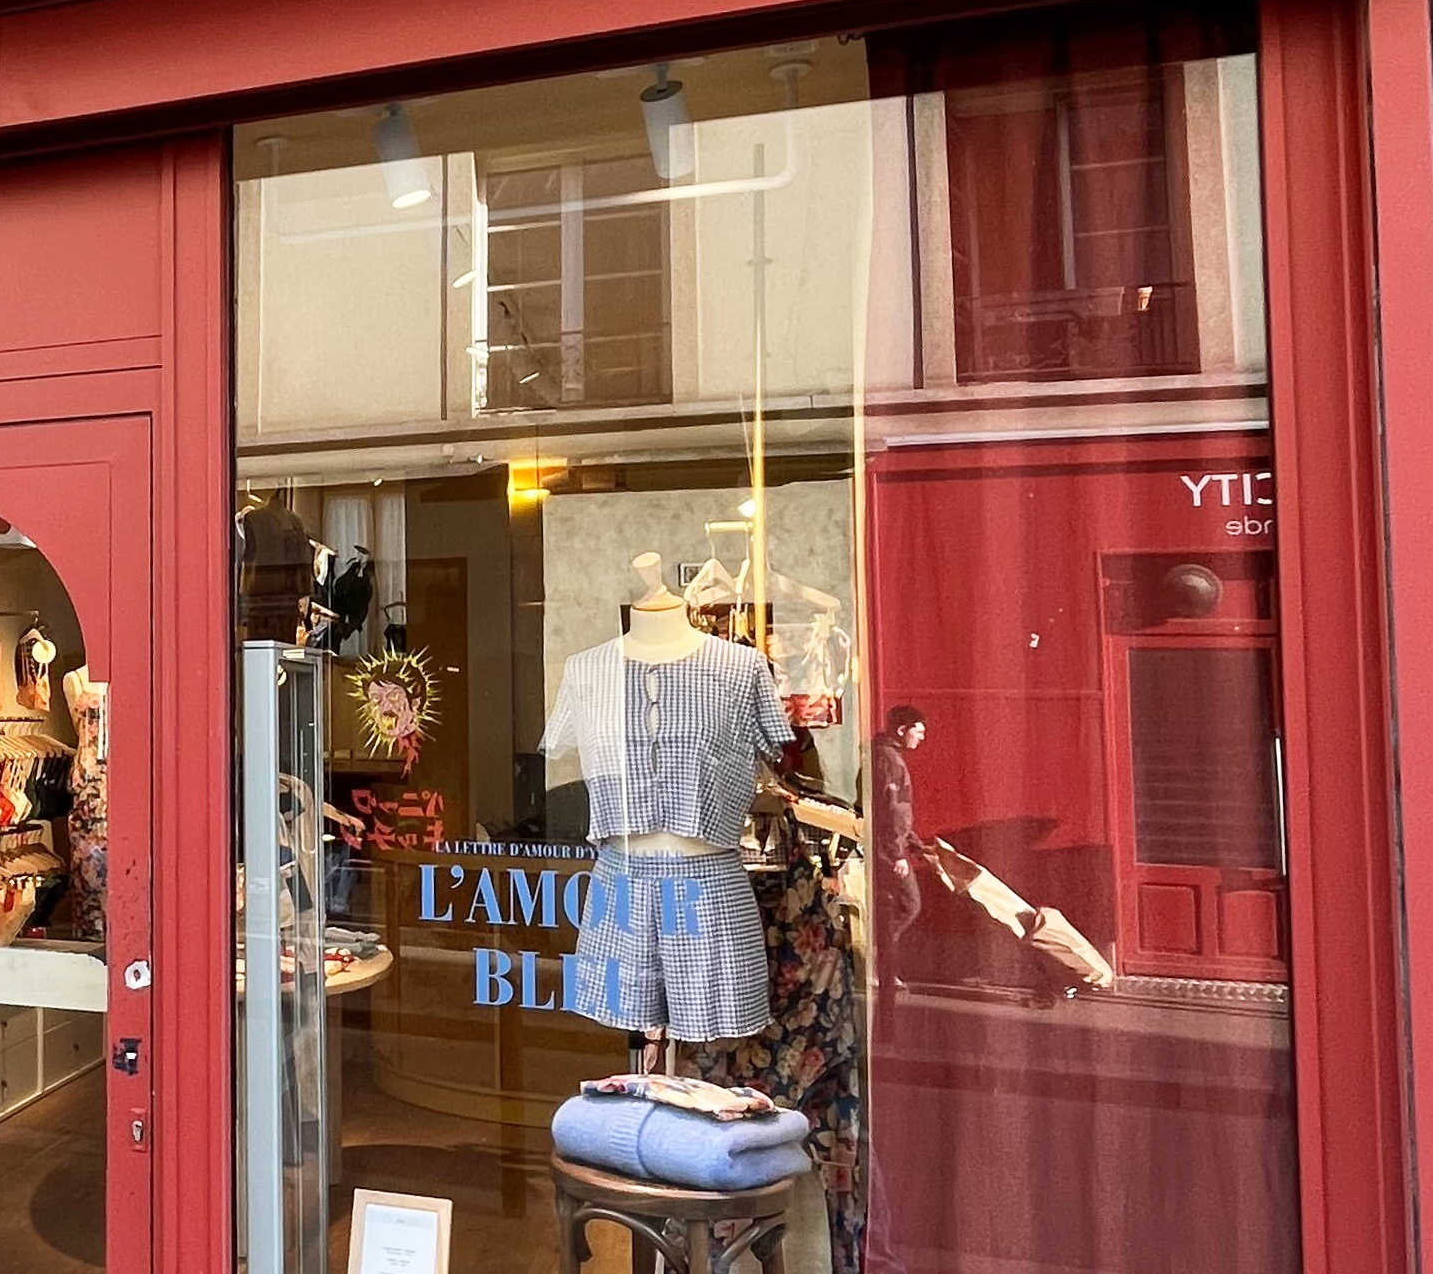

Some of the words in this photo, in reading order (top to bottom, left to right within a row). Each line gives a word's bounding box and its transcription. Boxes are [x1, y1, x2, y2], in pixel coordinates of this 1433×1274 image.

[454, 841, 505, 857] LETTRE
[510, 843, 571, 860] D'AMOUR
[419, 863, 705, 936] L'AMOUR
